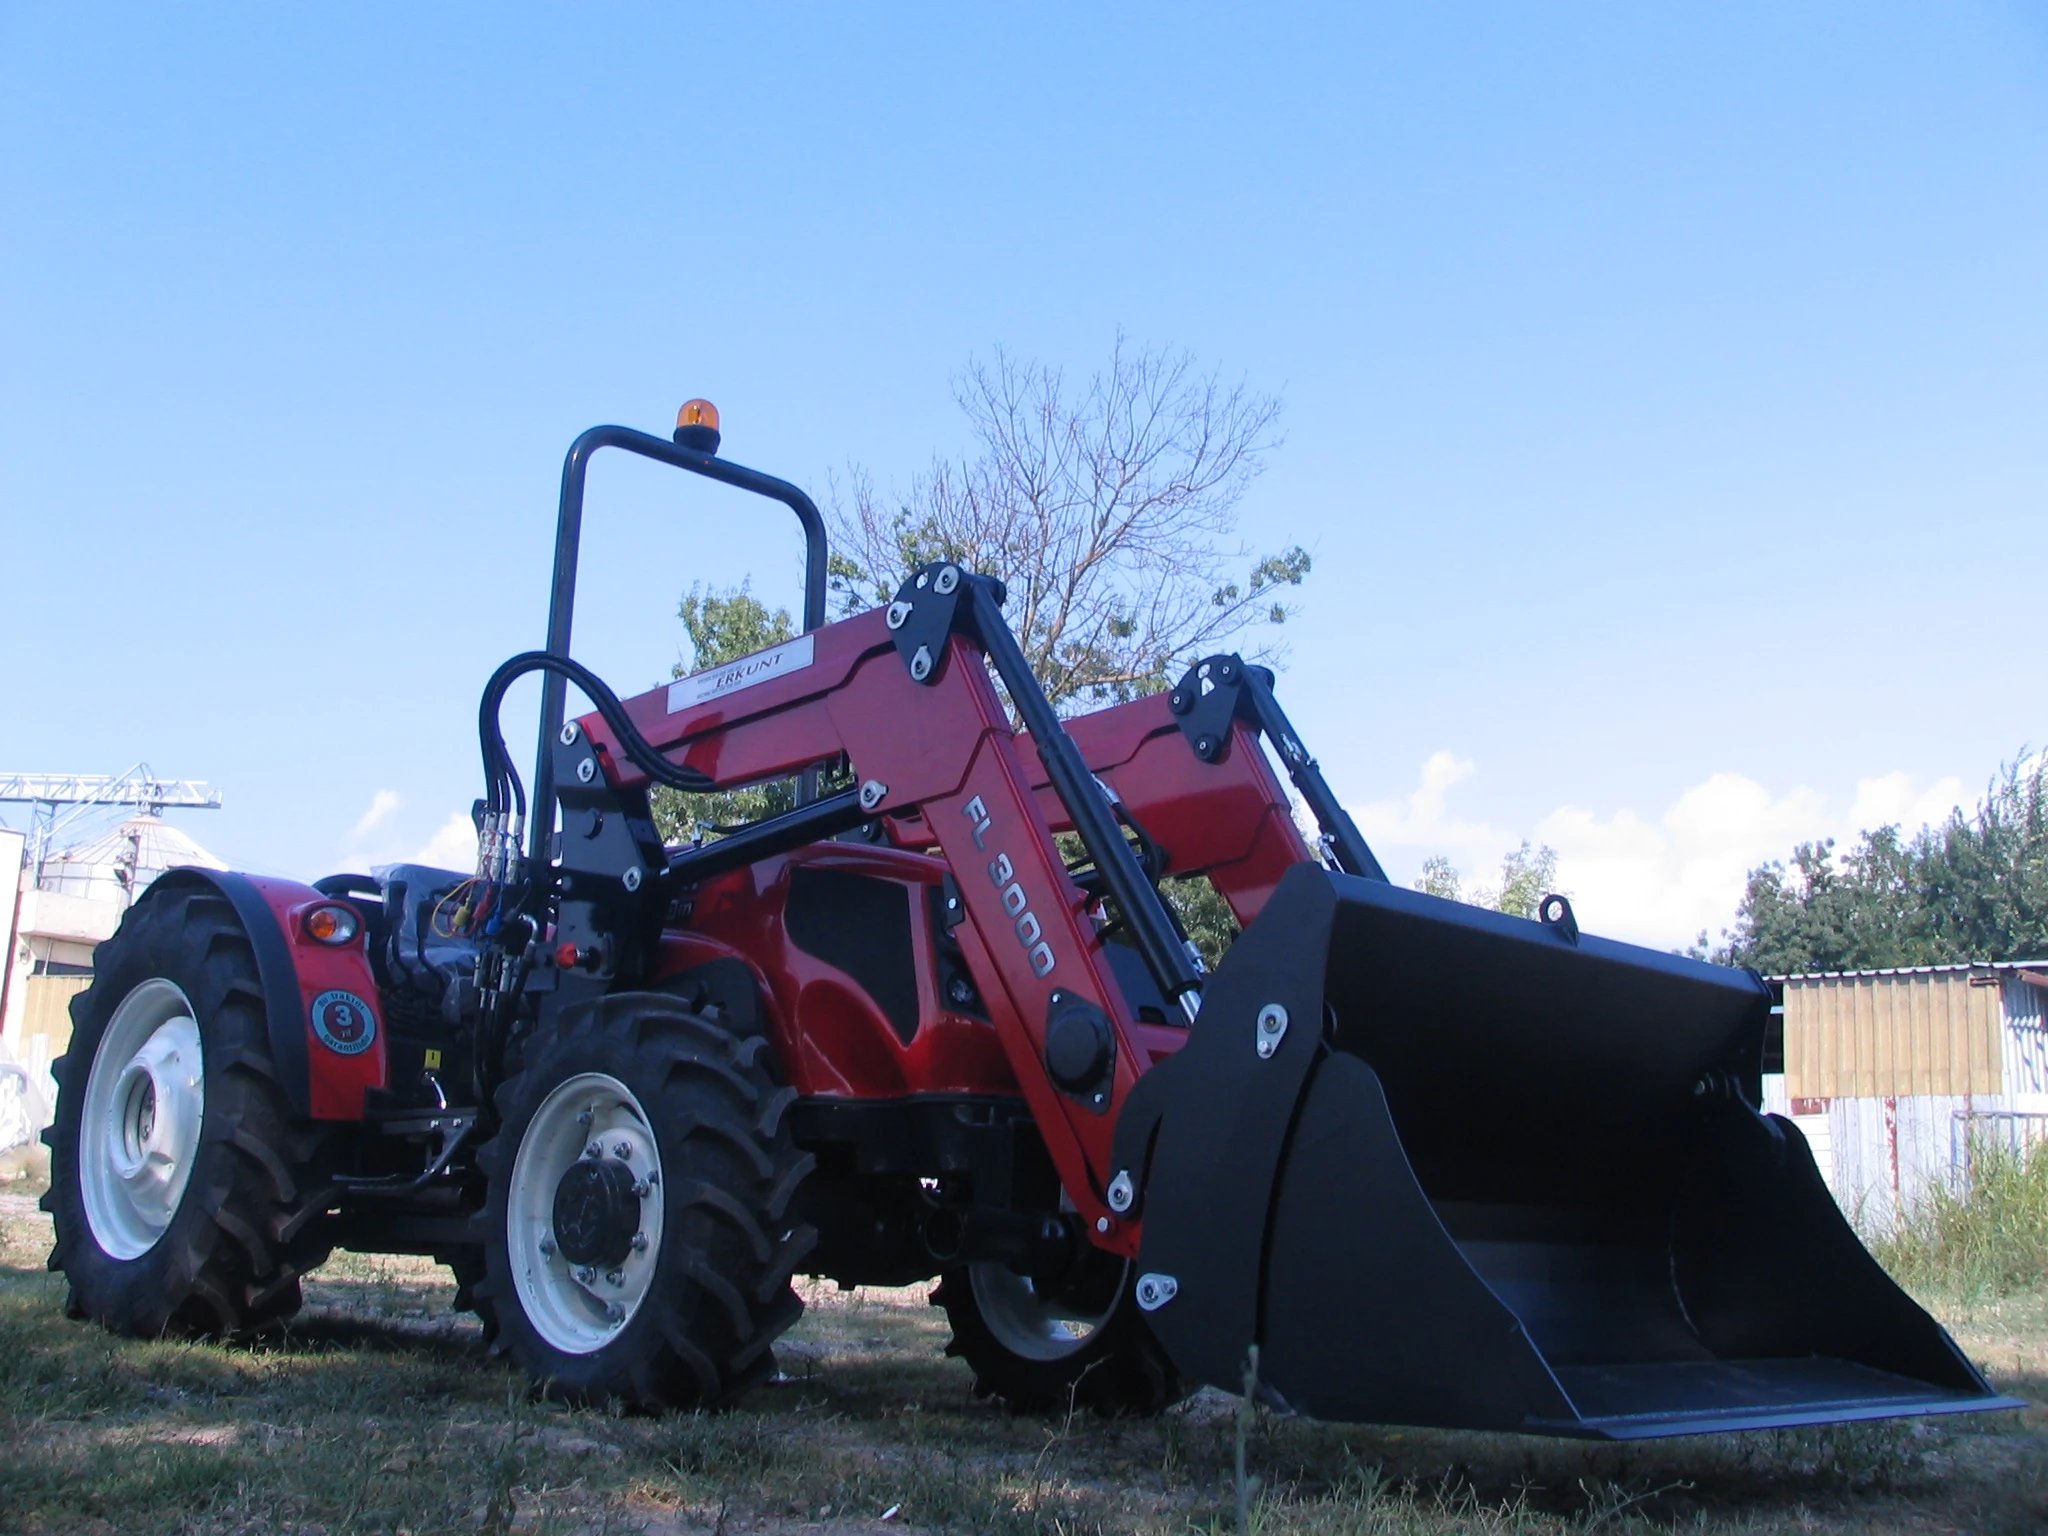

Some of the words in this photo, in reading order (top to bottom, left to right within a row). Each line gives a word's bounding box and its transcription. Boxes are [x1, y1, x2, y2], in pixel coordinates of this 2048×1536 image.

[716, 653, 784, 688] ERKUNT
[962, 794, 992, 850] FL
[987, 852, 1057, 980] 3000
[334, 1005, 353, 1027] 3
